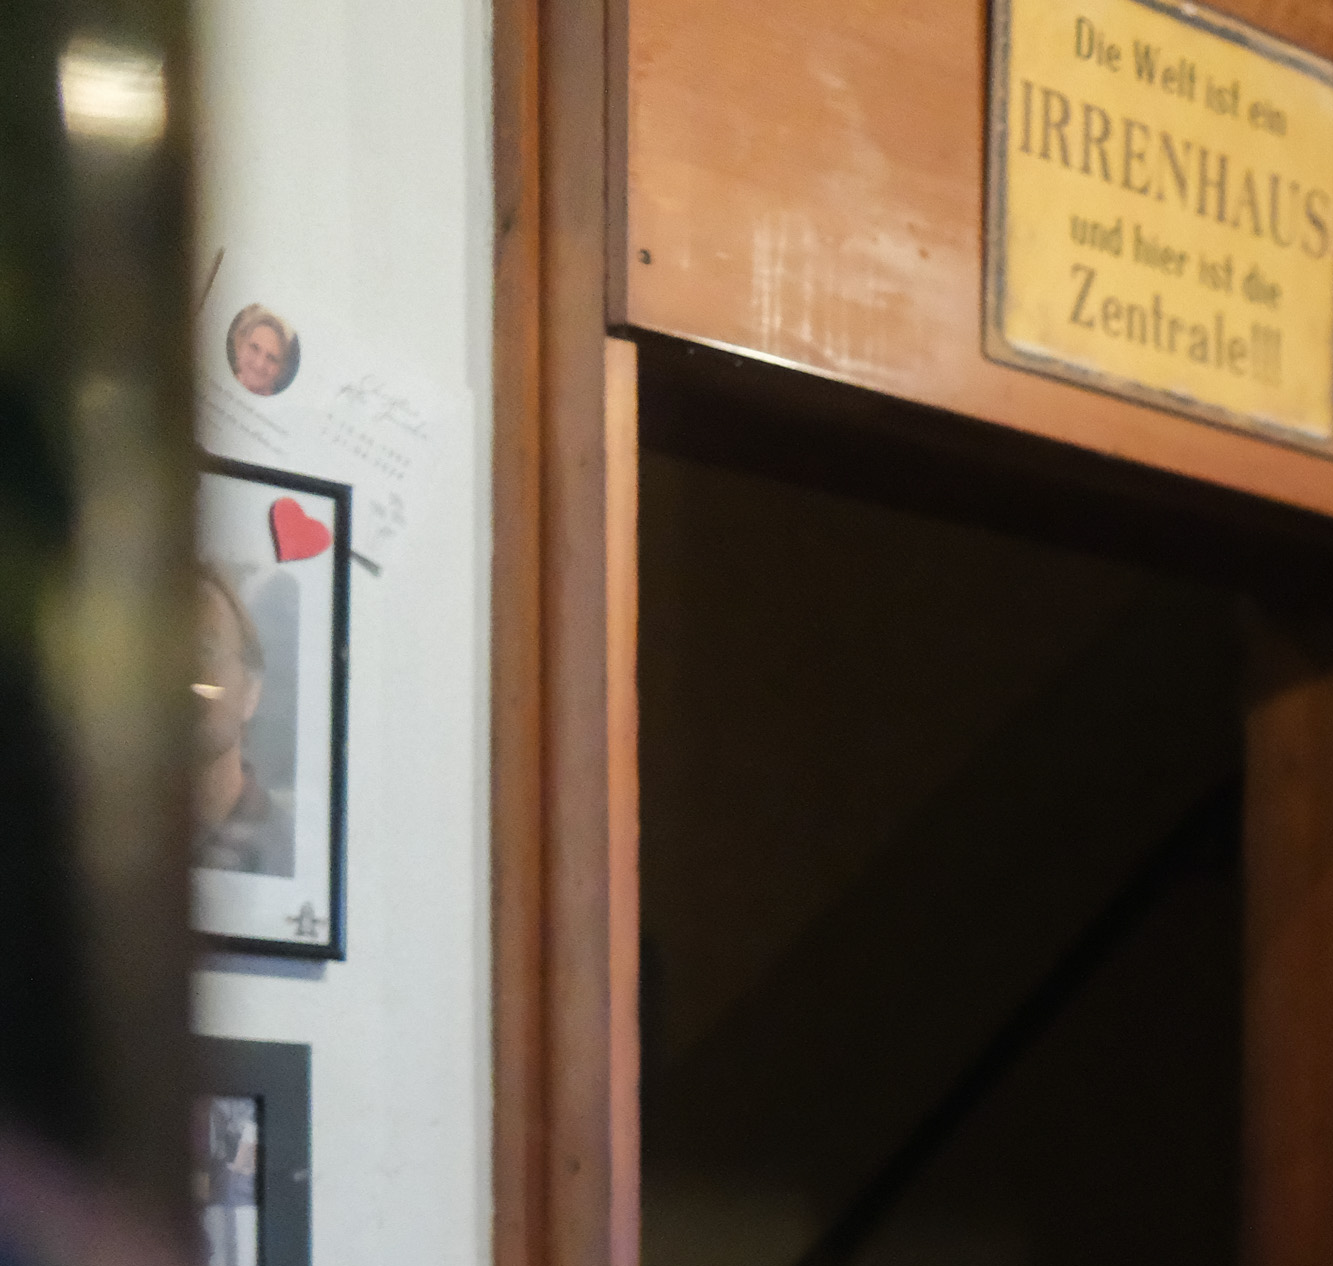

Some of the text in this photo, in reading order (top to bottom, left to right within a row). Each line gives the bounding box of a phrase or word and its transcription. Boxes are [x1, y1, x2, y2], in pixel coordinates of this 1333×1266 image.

[1074, 16, 1287, 137] Die Welt ist ein
[1019, 79, 1333, 260] IRRENHAUS
[1070, 214, 1123, 258] und
[1133, 222, 1190, 278] hier
[1199, 252, 1234, 295] ist
